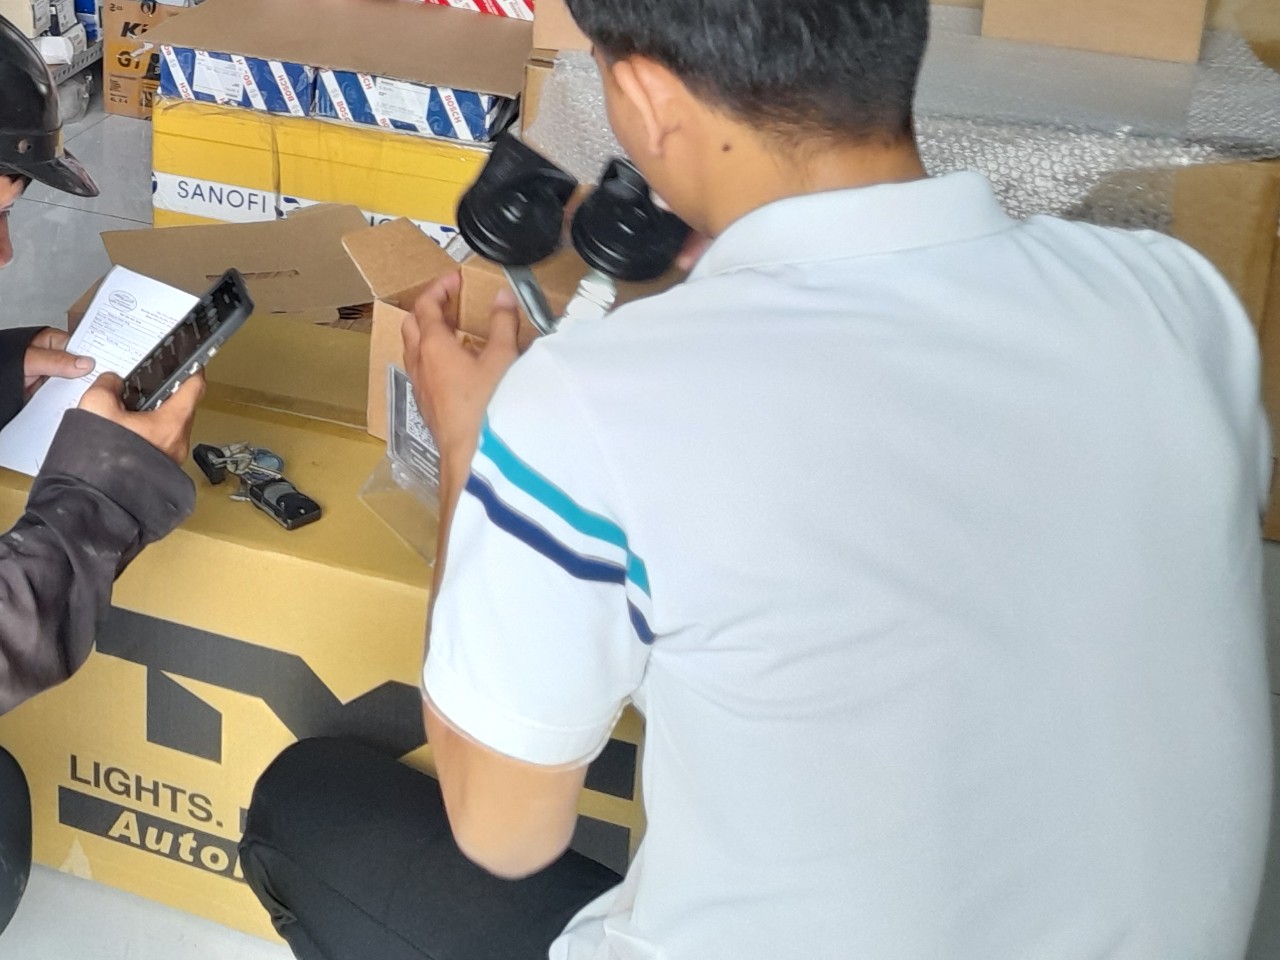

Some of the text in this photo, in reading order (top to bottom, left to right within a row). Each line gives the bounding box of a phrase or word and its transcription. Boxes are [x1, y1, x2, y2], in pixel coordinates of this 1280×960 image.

[278, 74, 295, 103] BOSCH
[444, 94, 462, 124] BOSCH
[176, 179, 267, 214] SANOFI
[69, 753, 225, 830] LIGHTS.
